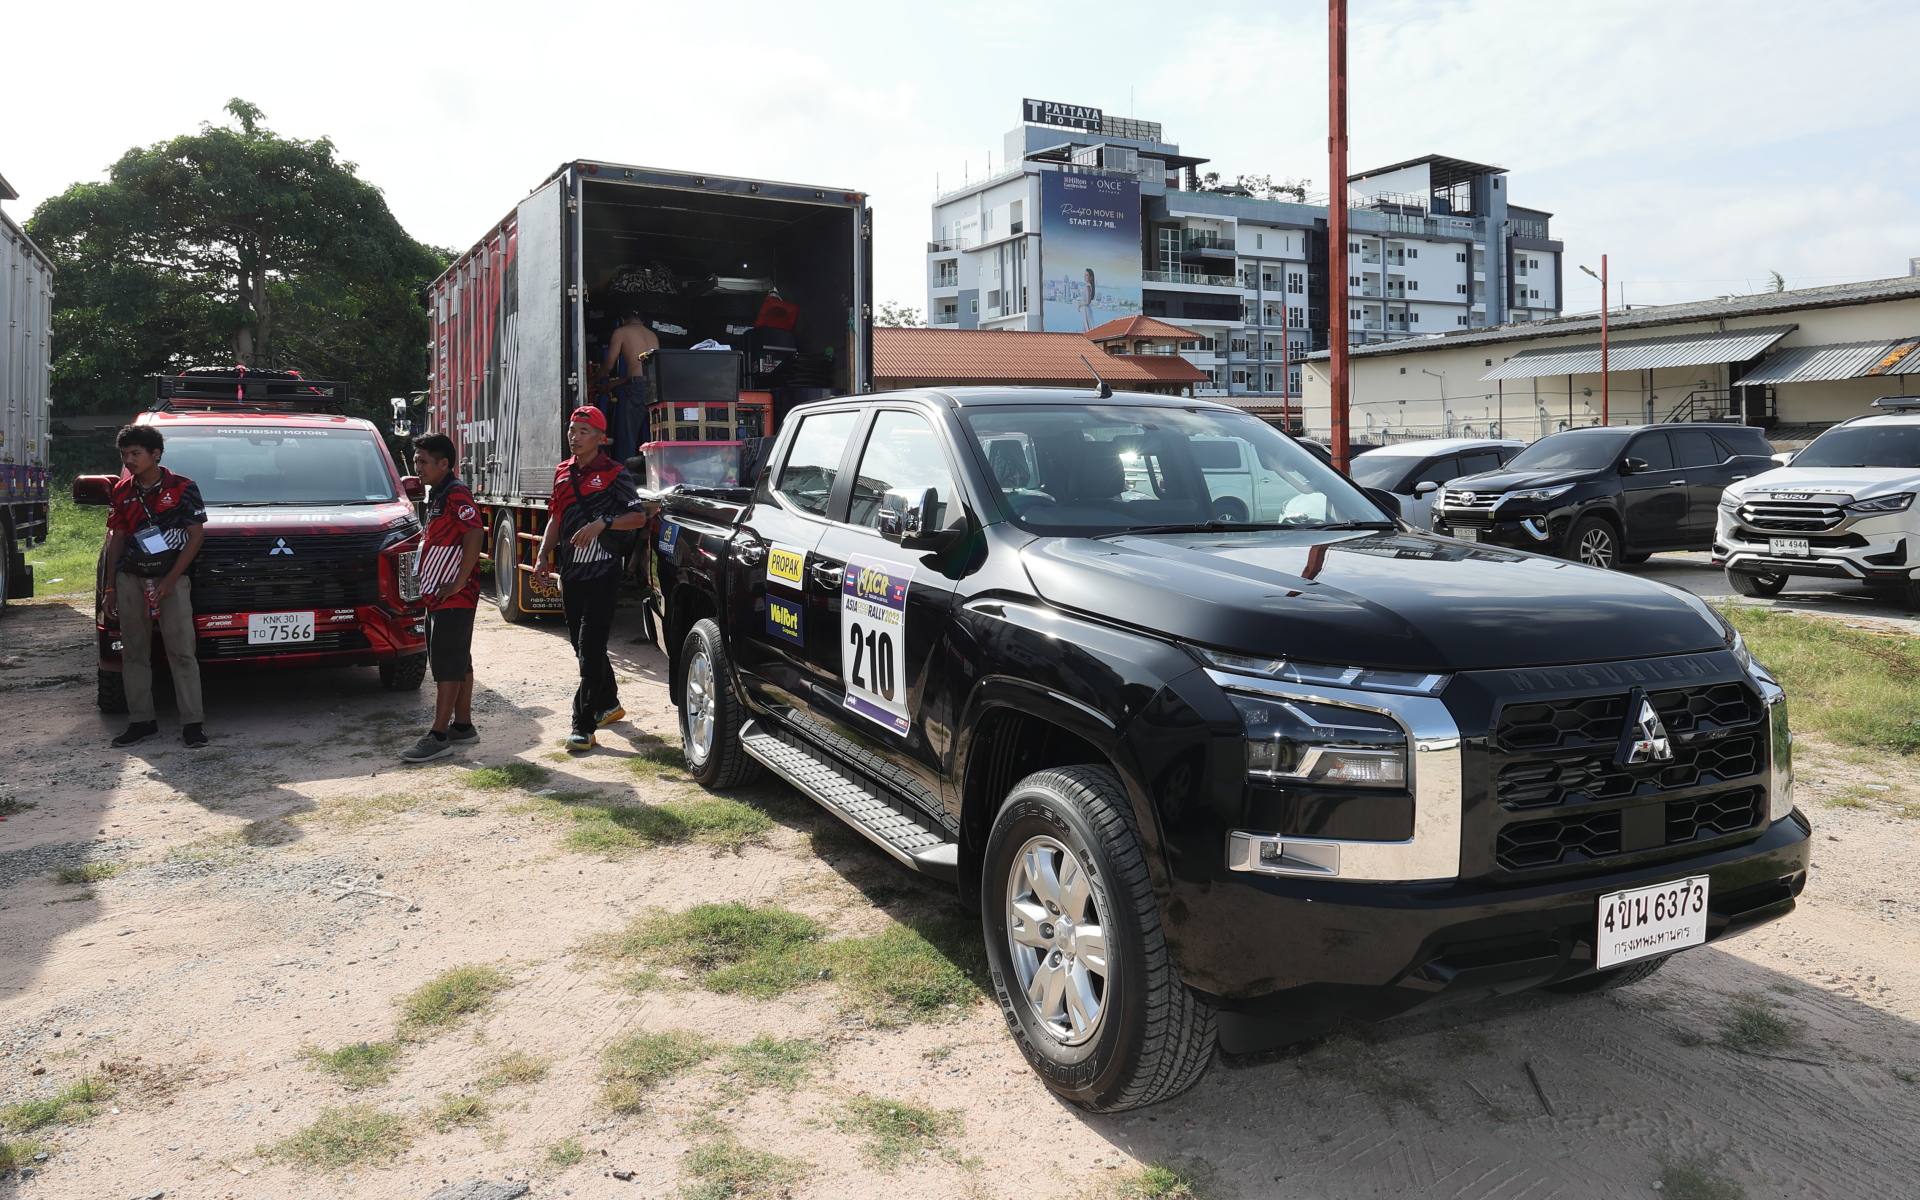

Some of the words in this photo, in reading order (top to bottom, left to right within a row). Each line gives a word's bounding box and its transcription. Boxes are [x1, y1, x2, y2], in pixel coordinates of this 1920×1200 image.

[1027, 99, 1043, 121] T
[1045, 102, 1100, 119] PATTAYA
[1045, 115, 1100, 130] HOTEL
[1068, 177, 1087, 185] Hilton
[1096, 179, 1122, 191] ONCE
[1069, 217, 1092, 226] START
[1092, 219, 1103, 227] 3.7
[1081, 208, 1092, 216] TO
[1093, 209, 1115, 218] MOVE
[1788, 539, 1808, 549] 4944
[771, 553, 799, 577] PROPAK
[858, 566, 890, 597] AXCR
[263, 615, 283, 625] KNK
[283, 614, 299, 623] 301
[845, 598, 858, 613] ASIA
[867, 604, 886, 622] RALLY
[252, 629, 266, 639] TO
[269, 624, 311, 641] 7566
[850, 621, 895, 702] 210
[1507, 656, 1722, 691] MITSUBISHI
[1654, 884, 1704, 922] 6373
[1613, 926, 1691, 957] กรุงเทพมหานคร
